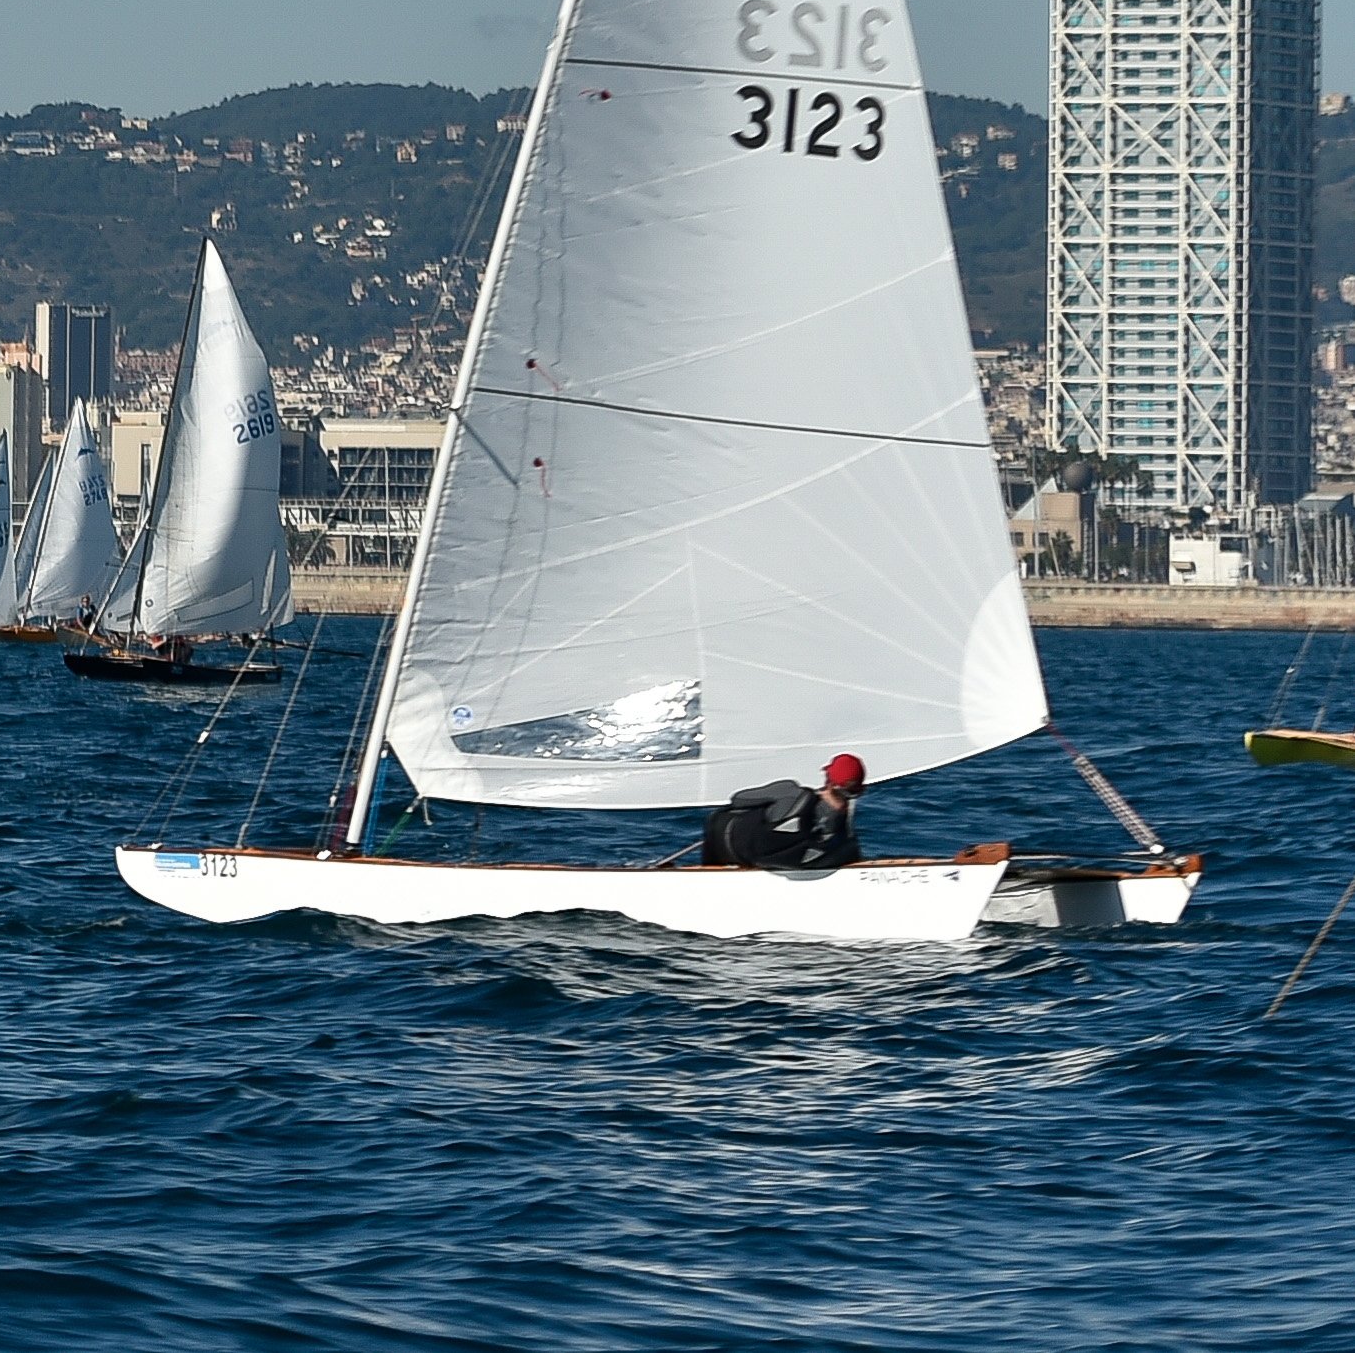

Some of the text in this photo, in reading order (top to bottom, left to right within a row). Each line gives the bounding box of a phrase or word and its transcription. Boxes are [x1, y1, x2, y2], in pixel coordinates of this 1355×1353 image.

[730, 85, 886, 161] 3123
[232, 413, 275, 444] 2619
[201, 853, 238, 878] 3123
